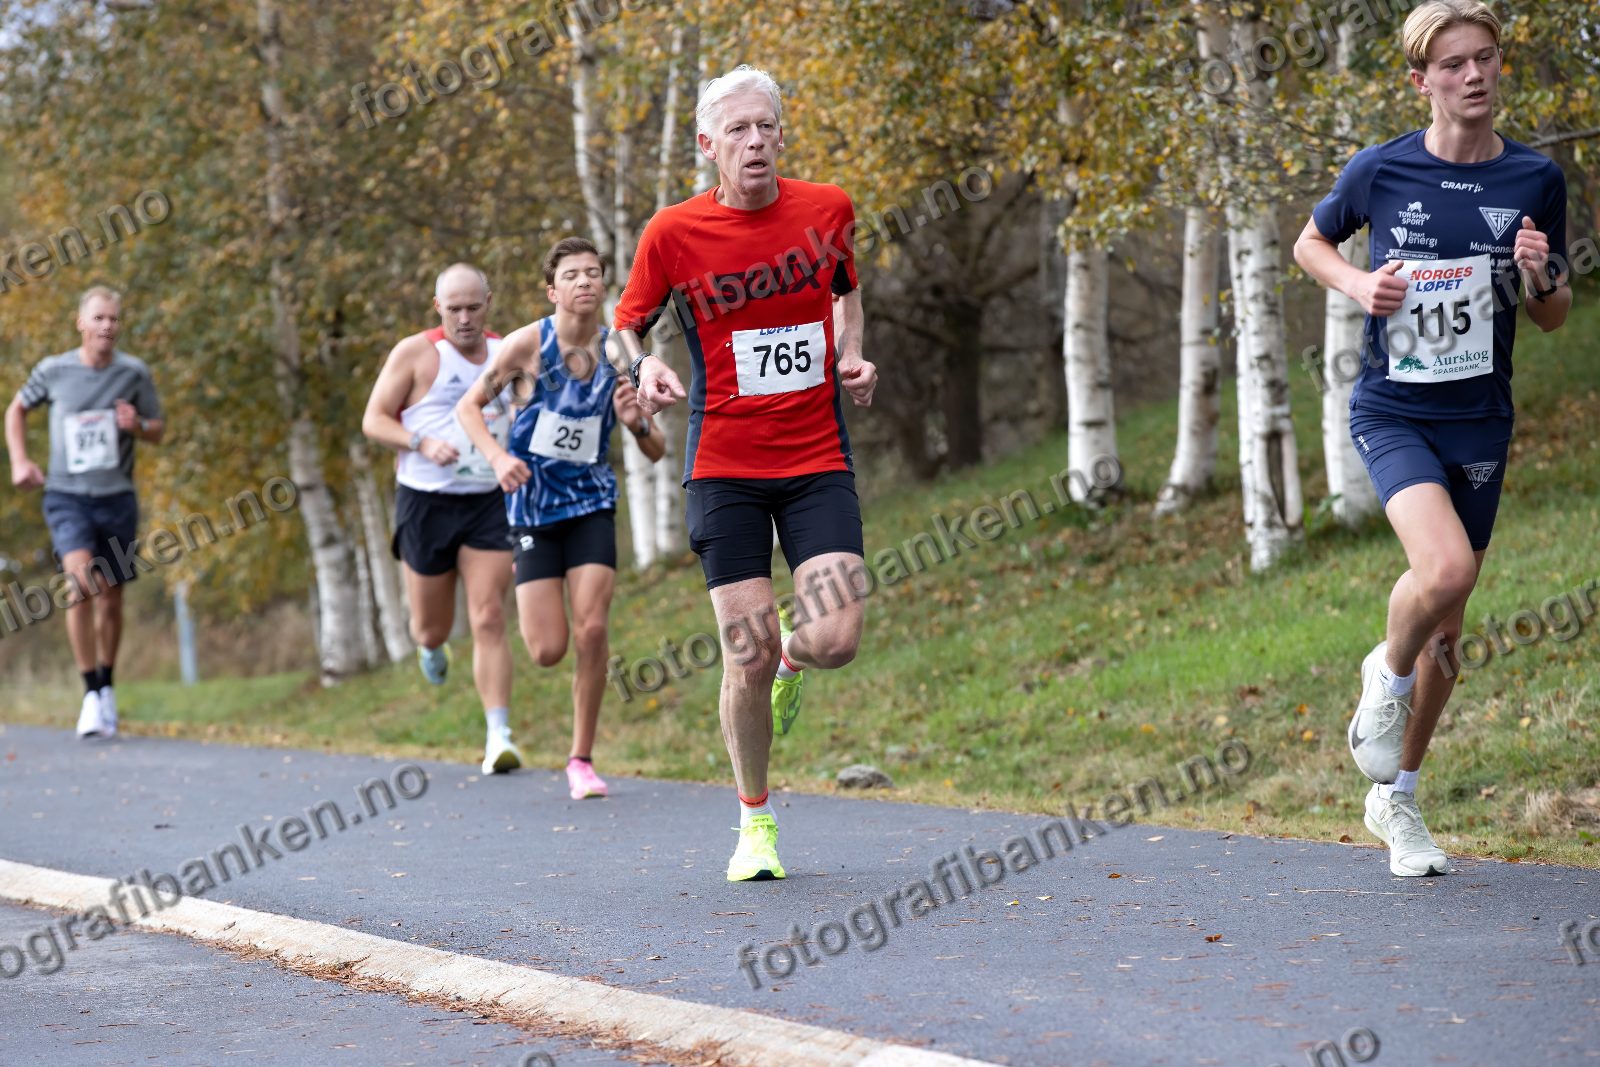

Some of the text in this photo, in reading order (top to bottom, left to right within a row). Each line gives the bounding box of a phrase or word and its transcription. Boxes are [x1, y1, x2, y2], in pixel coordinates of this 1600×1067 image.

[1441, 181, 1474, 192] CRAFT
[1398, 210, 1431, 221] TORSHOV
[1401, 218, 1425, 226] SPORT
[1408, 236, 1438, 248] energi
[1410, 266, 1474, 280] NORGES
[1416, 279, 1463, 292] LØPET
[1410, 300, 1472, 337] 115
[753, 340, 812, 378] 765
[1433, 349, 1489, 367] Aurskog
[1432, 363, 1480, 375] SPAREBANK
[553, 425, 583, 451] 25
